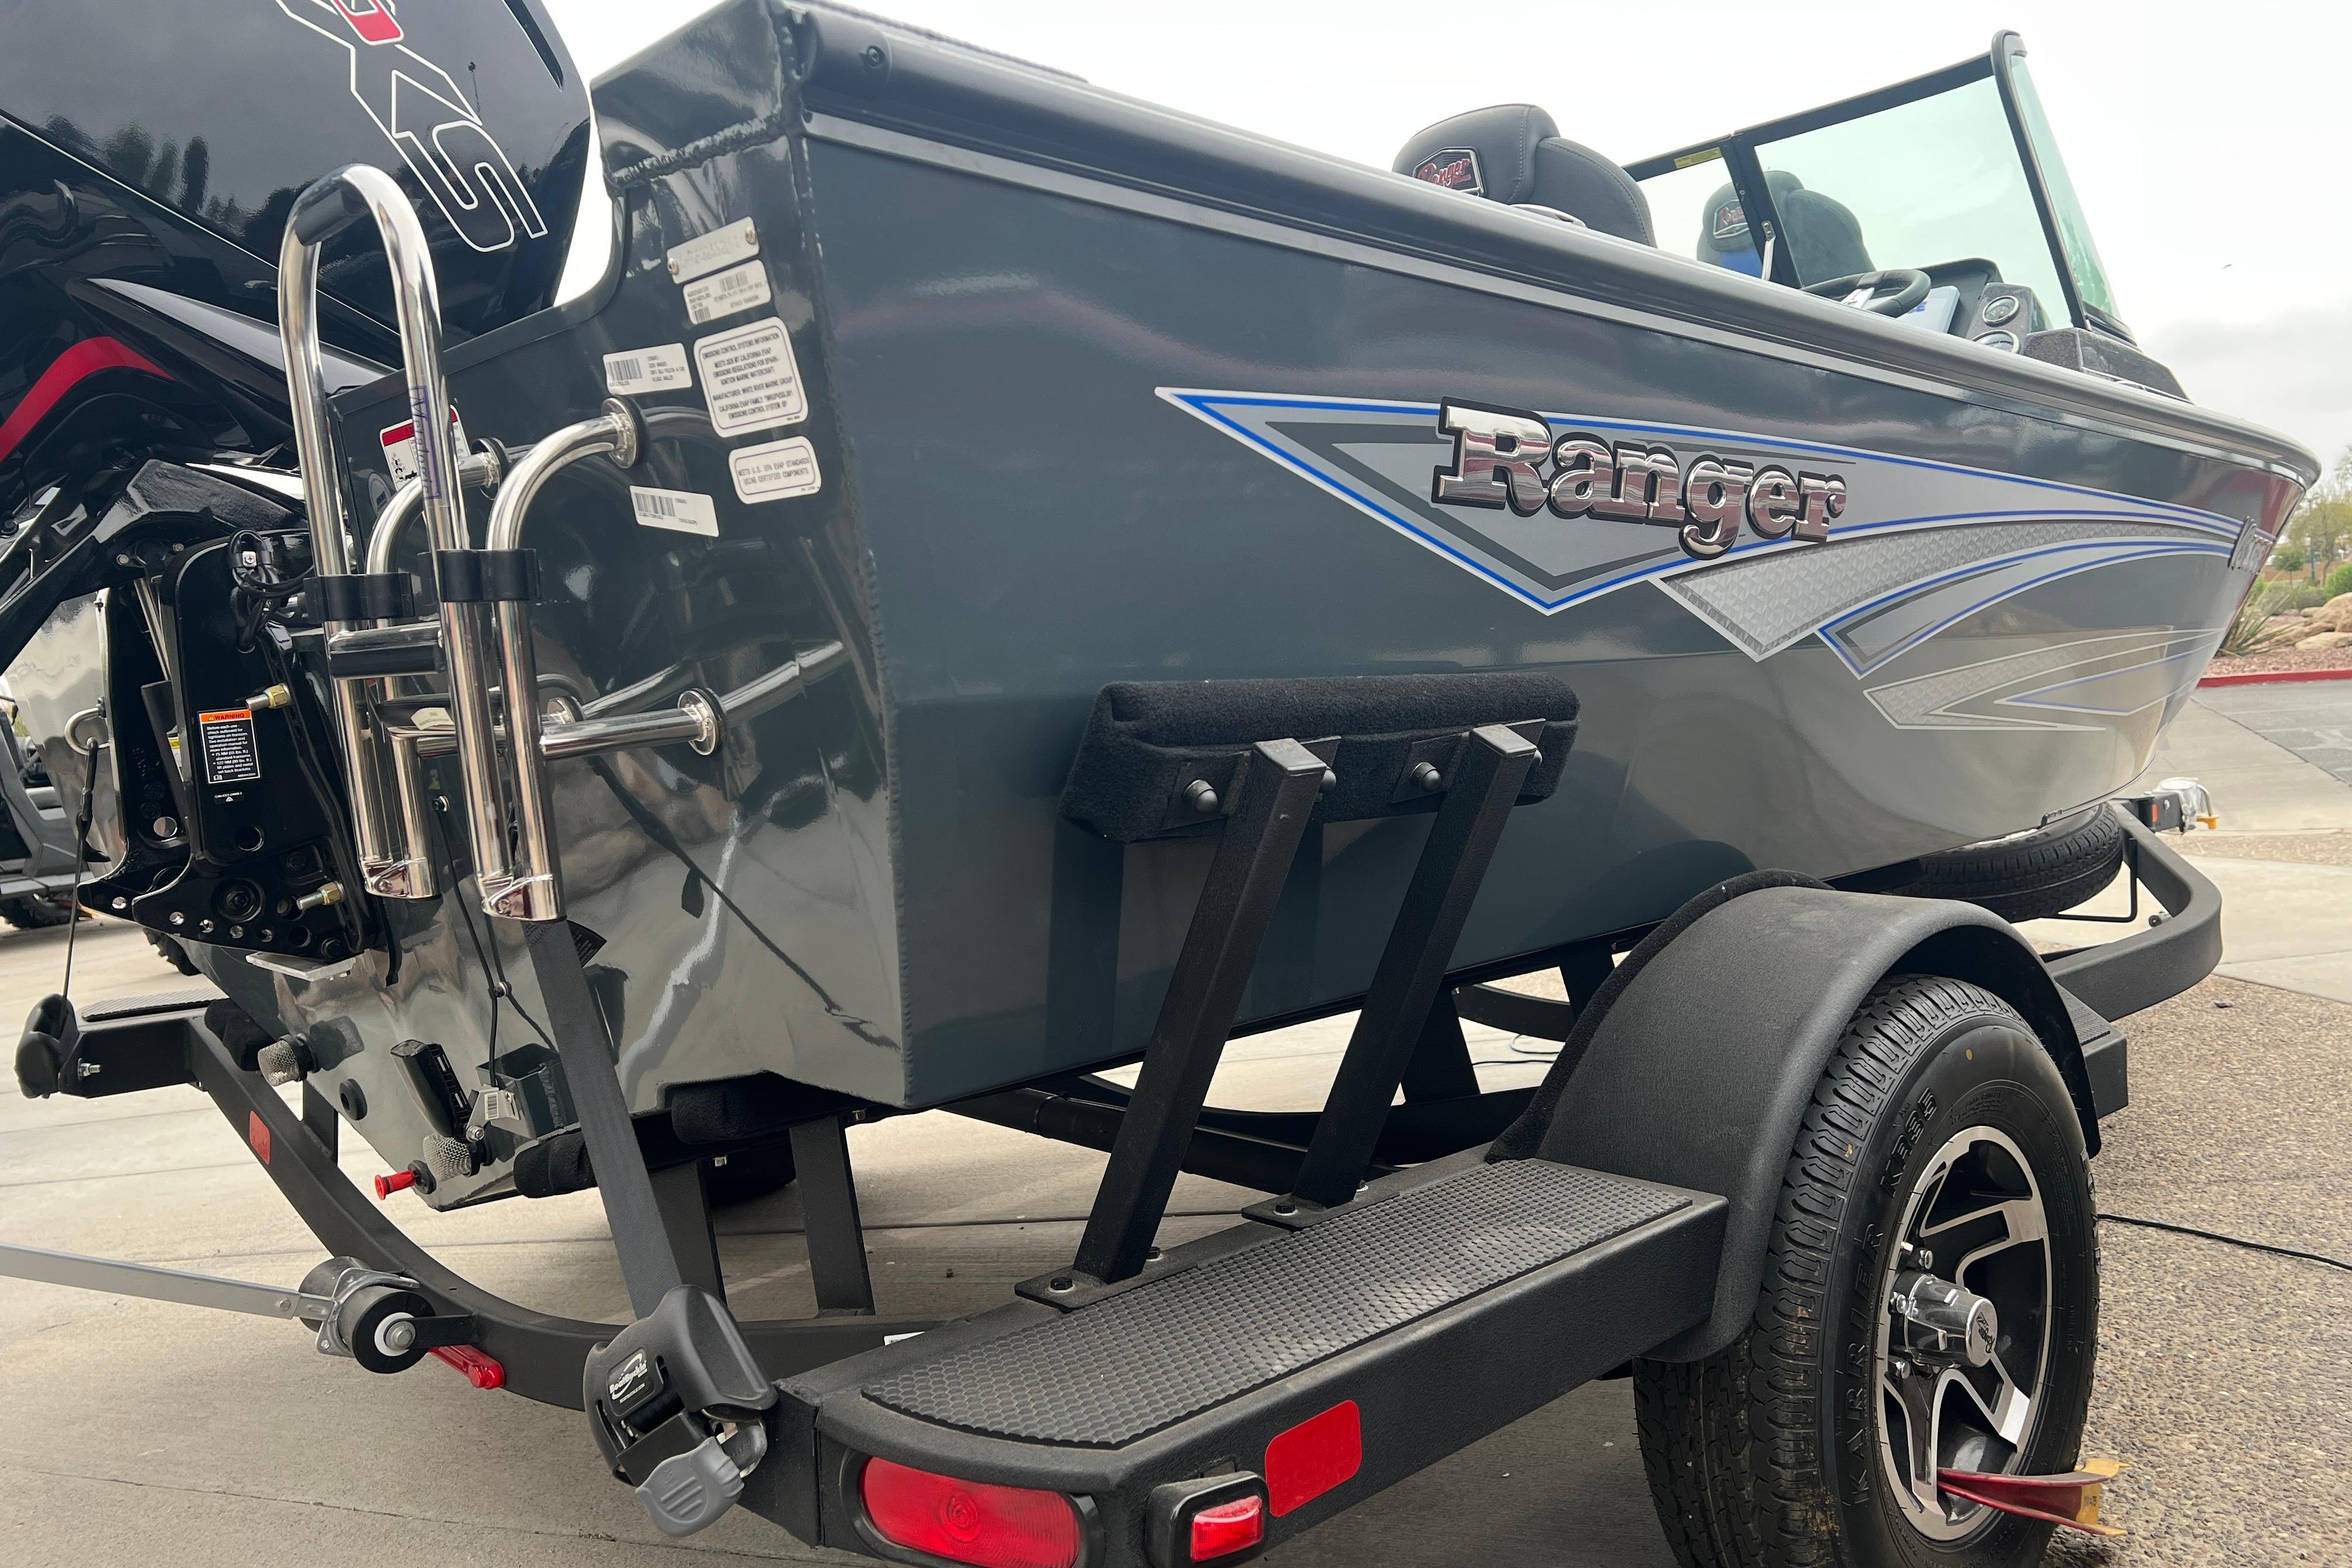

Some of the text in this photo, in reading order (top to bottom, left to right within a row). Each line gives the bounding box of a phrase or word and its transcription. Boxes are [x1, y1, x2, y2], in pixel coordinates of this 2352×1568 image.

[702, 348, 720, 359] EMISSIONS
[720, 344, 738, 355] CONTROL
[755, 332, 780, 345] INFORMATION
[740, 351, 762, 362] CALIFORNIA
[713, 369, 732, 378] EMISSIONS
[741, 386, 753, 394] WHITE
[754, 383, 765, 391] RIVER
[765, 380, 779, 388] MARINE
[779, 376, 793, 386] GROUP
[719, 402, 740, 412] CALIFORNIA
[729, 410, 748, 419] EMISSIONS
[748, 407, 765, 416] CONTROL
[738, 468, 751, 477] MEETS
[774, 461, 785, 470] EVAP
[758, 473, 781, 482] CERTIFIED
[783, 468, 809, 478] COMPONENTS
[1432, 397, 1847, 559] Ranger
[1846, 1223, 1884, 1504] KARRIER
